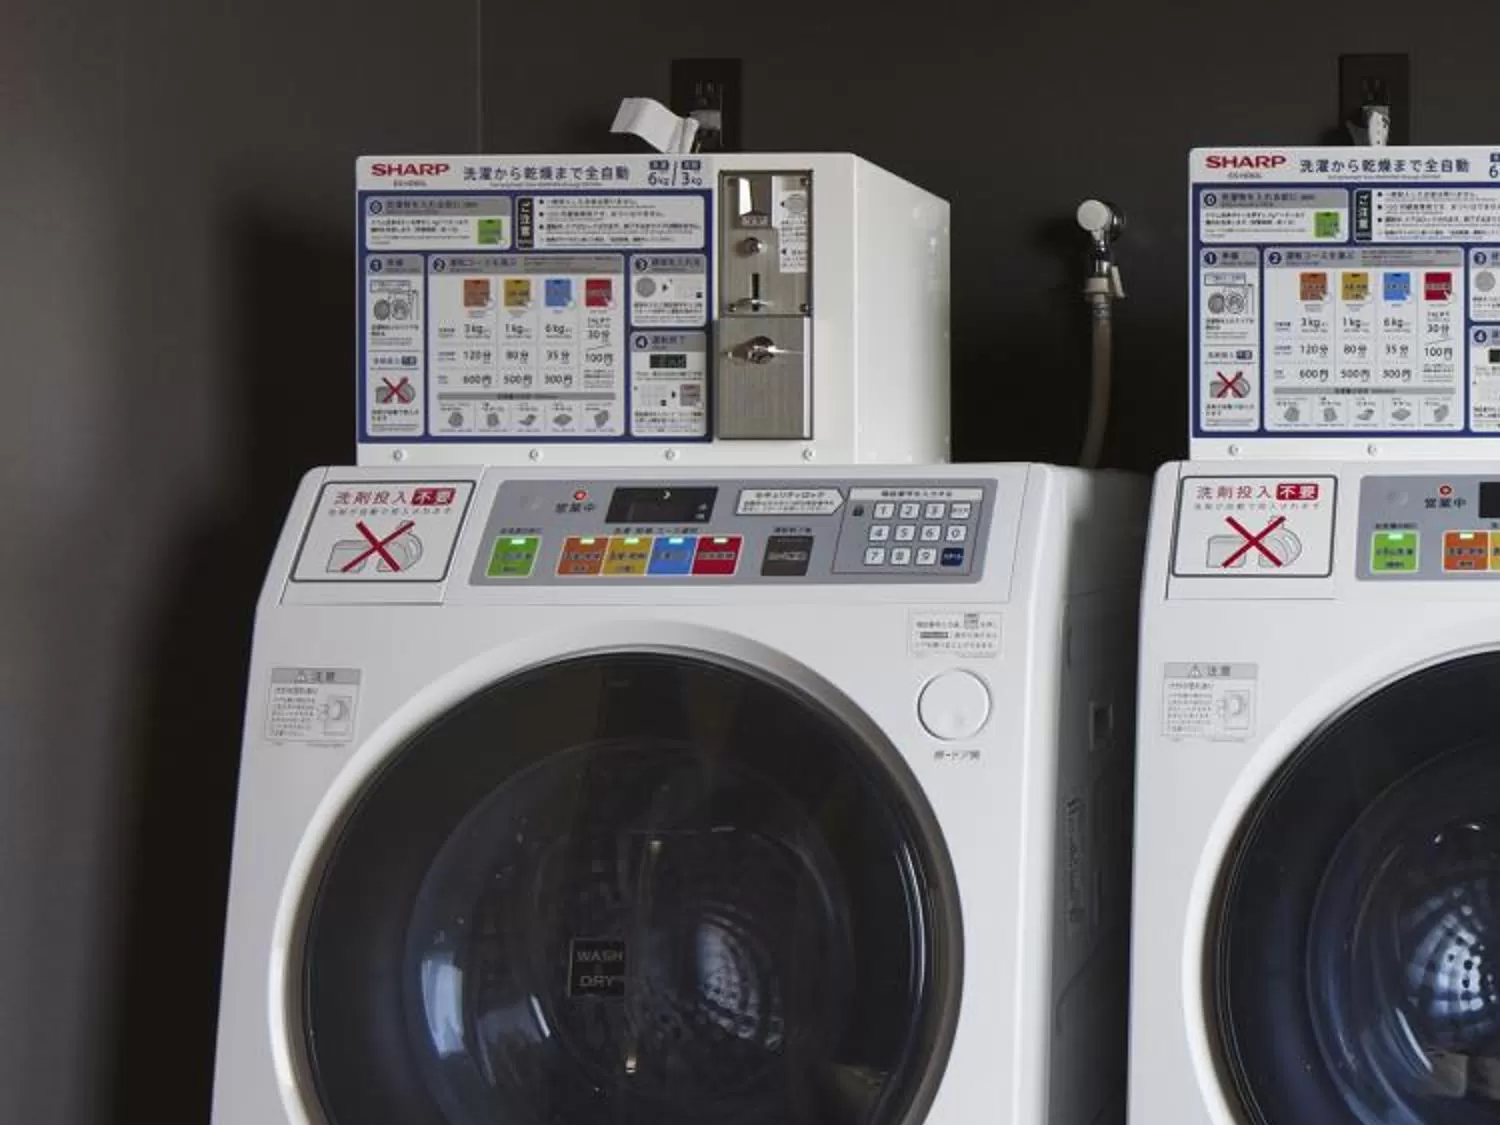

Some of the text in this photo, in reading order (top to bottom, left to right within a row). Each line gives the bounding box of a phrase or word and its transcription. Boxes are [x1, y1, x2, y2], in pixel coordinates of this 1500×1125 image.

[1205, 155, 1286, 168] SHARP
[1300, 159, 1470, 174] 洗濯から乾燥まで全自動
[371, 163, 449, 177] SHARP
[464, 165, 630, 182] 洗濯から乾燥まで全自動
[1196, 486, 1272, 500] 洗剤投入
[576, 950, 623, 961] WASH
[580, 975, 615, 987] DRY
